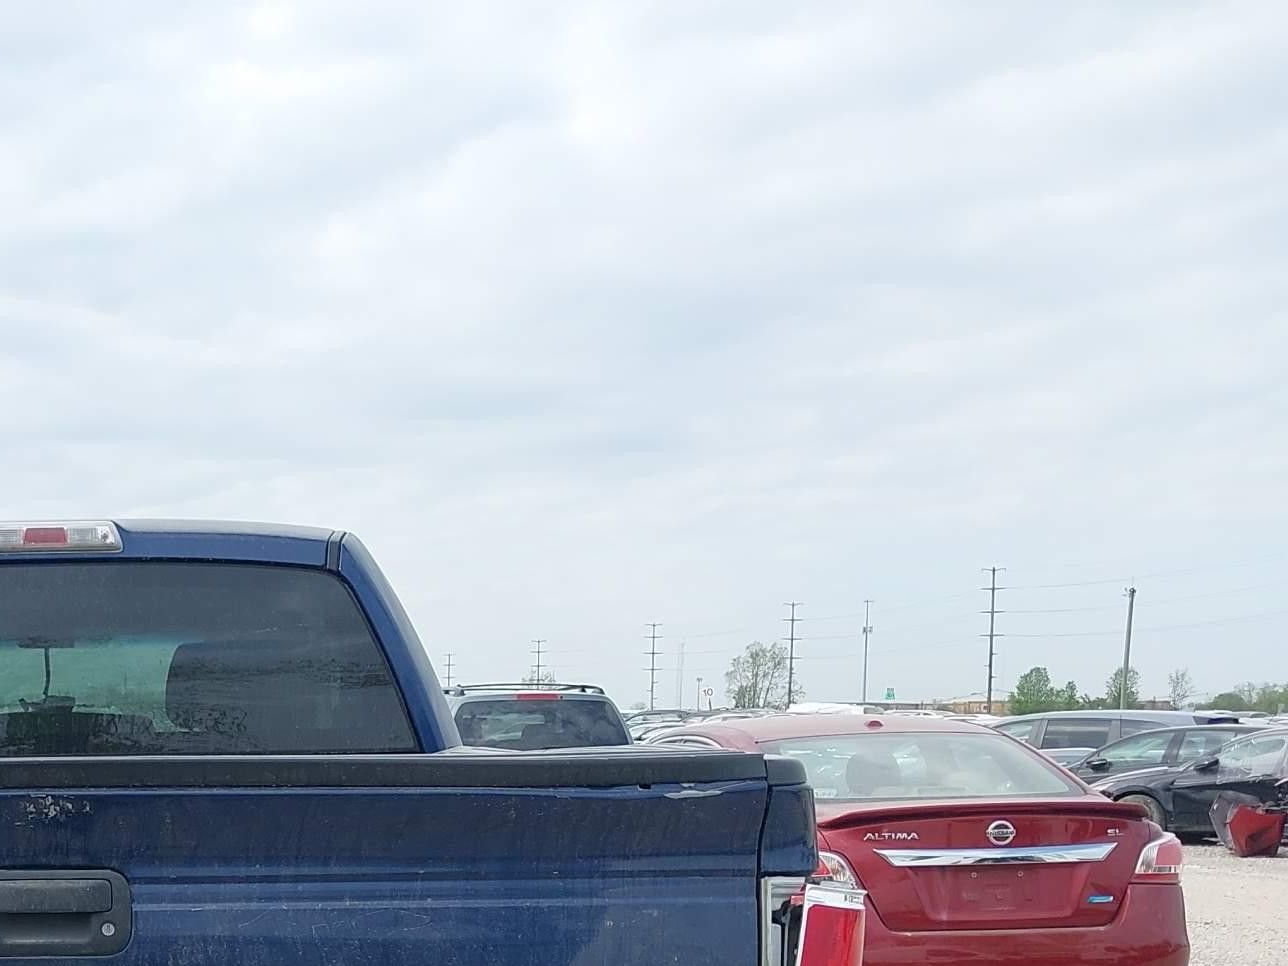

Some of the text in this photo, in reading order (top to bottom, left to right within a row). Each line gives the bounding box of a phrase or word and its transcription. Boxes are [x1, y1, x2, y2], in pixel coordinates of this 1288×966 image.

[703, 688, 714, 697] 10
[863, 832, 920, 841] ALTIMA
[1107, 828, 1124, 836] SL
